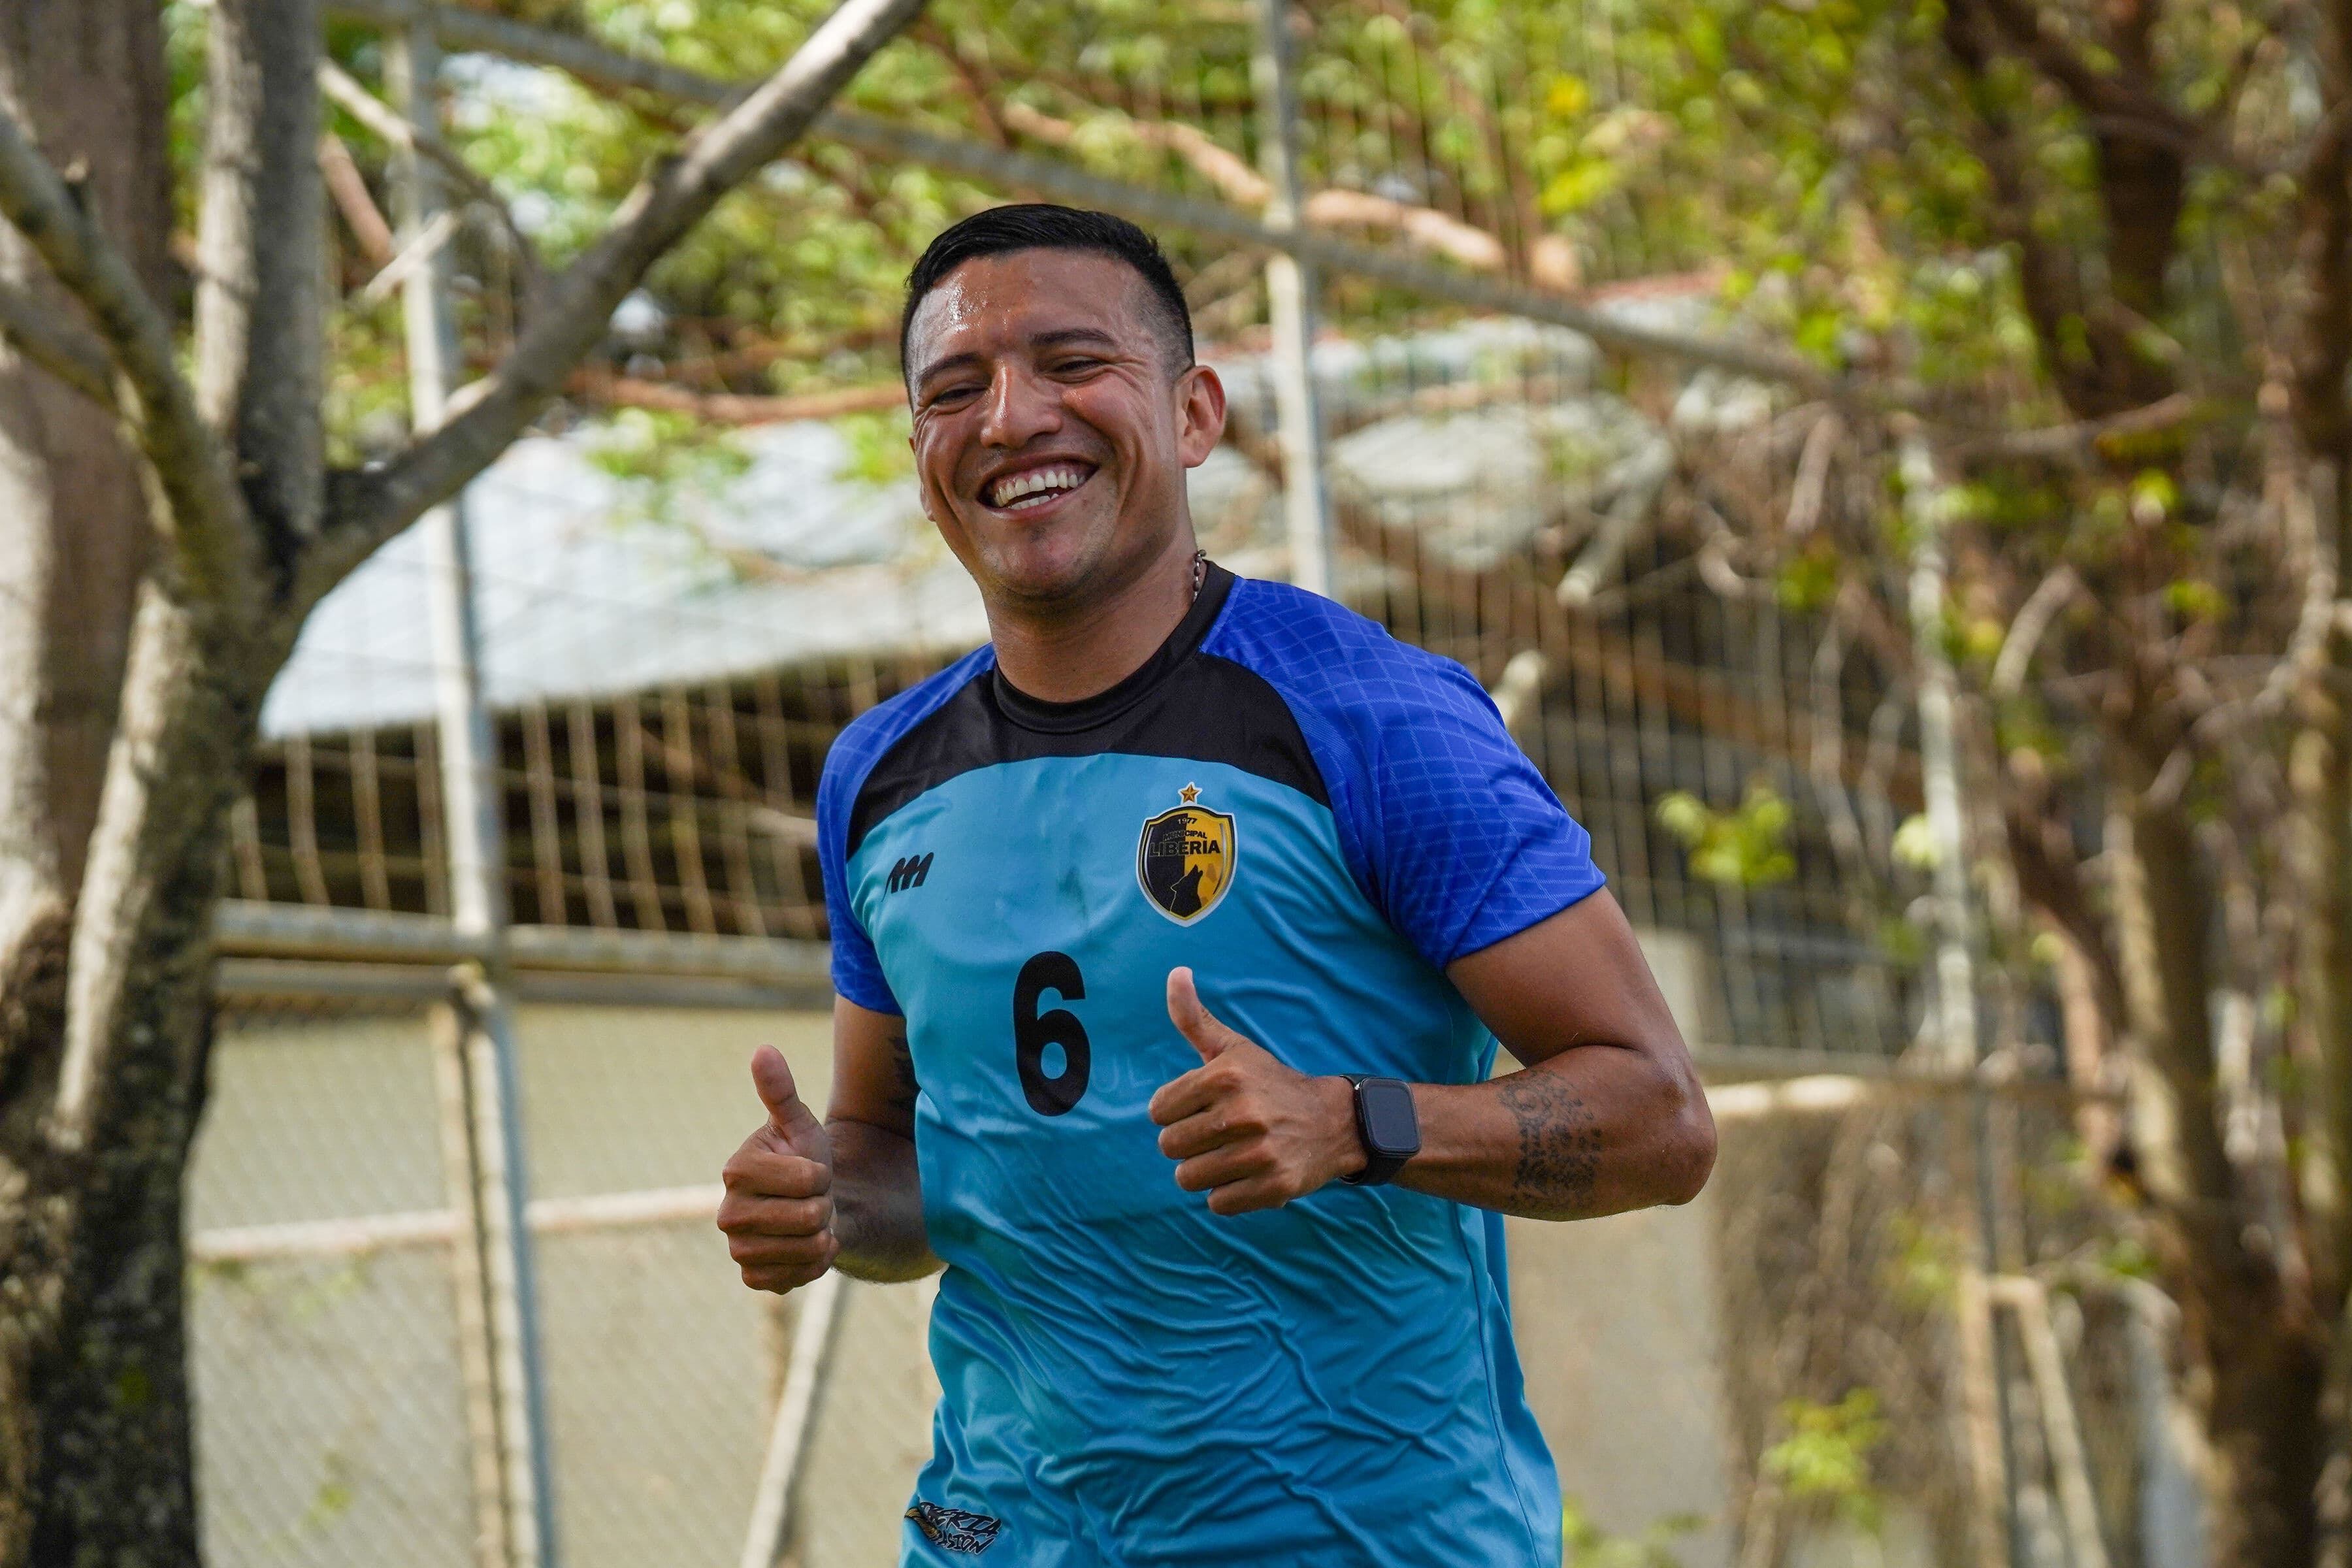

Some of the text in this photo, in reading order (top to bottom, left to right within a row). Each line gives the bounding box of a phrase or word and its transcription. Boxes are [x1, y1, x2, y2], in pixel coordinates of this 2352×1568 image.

[1163, 830, 1207, 841] MUNICIPAL
[1149, 840, 1220, 857] LIBERIA
[1013, 951, 1091, 1117] 6
